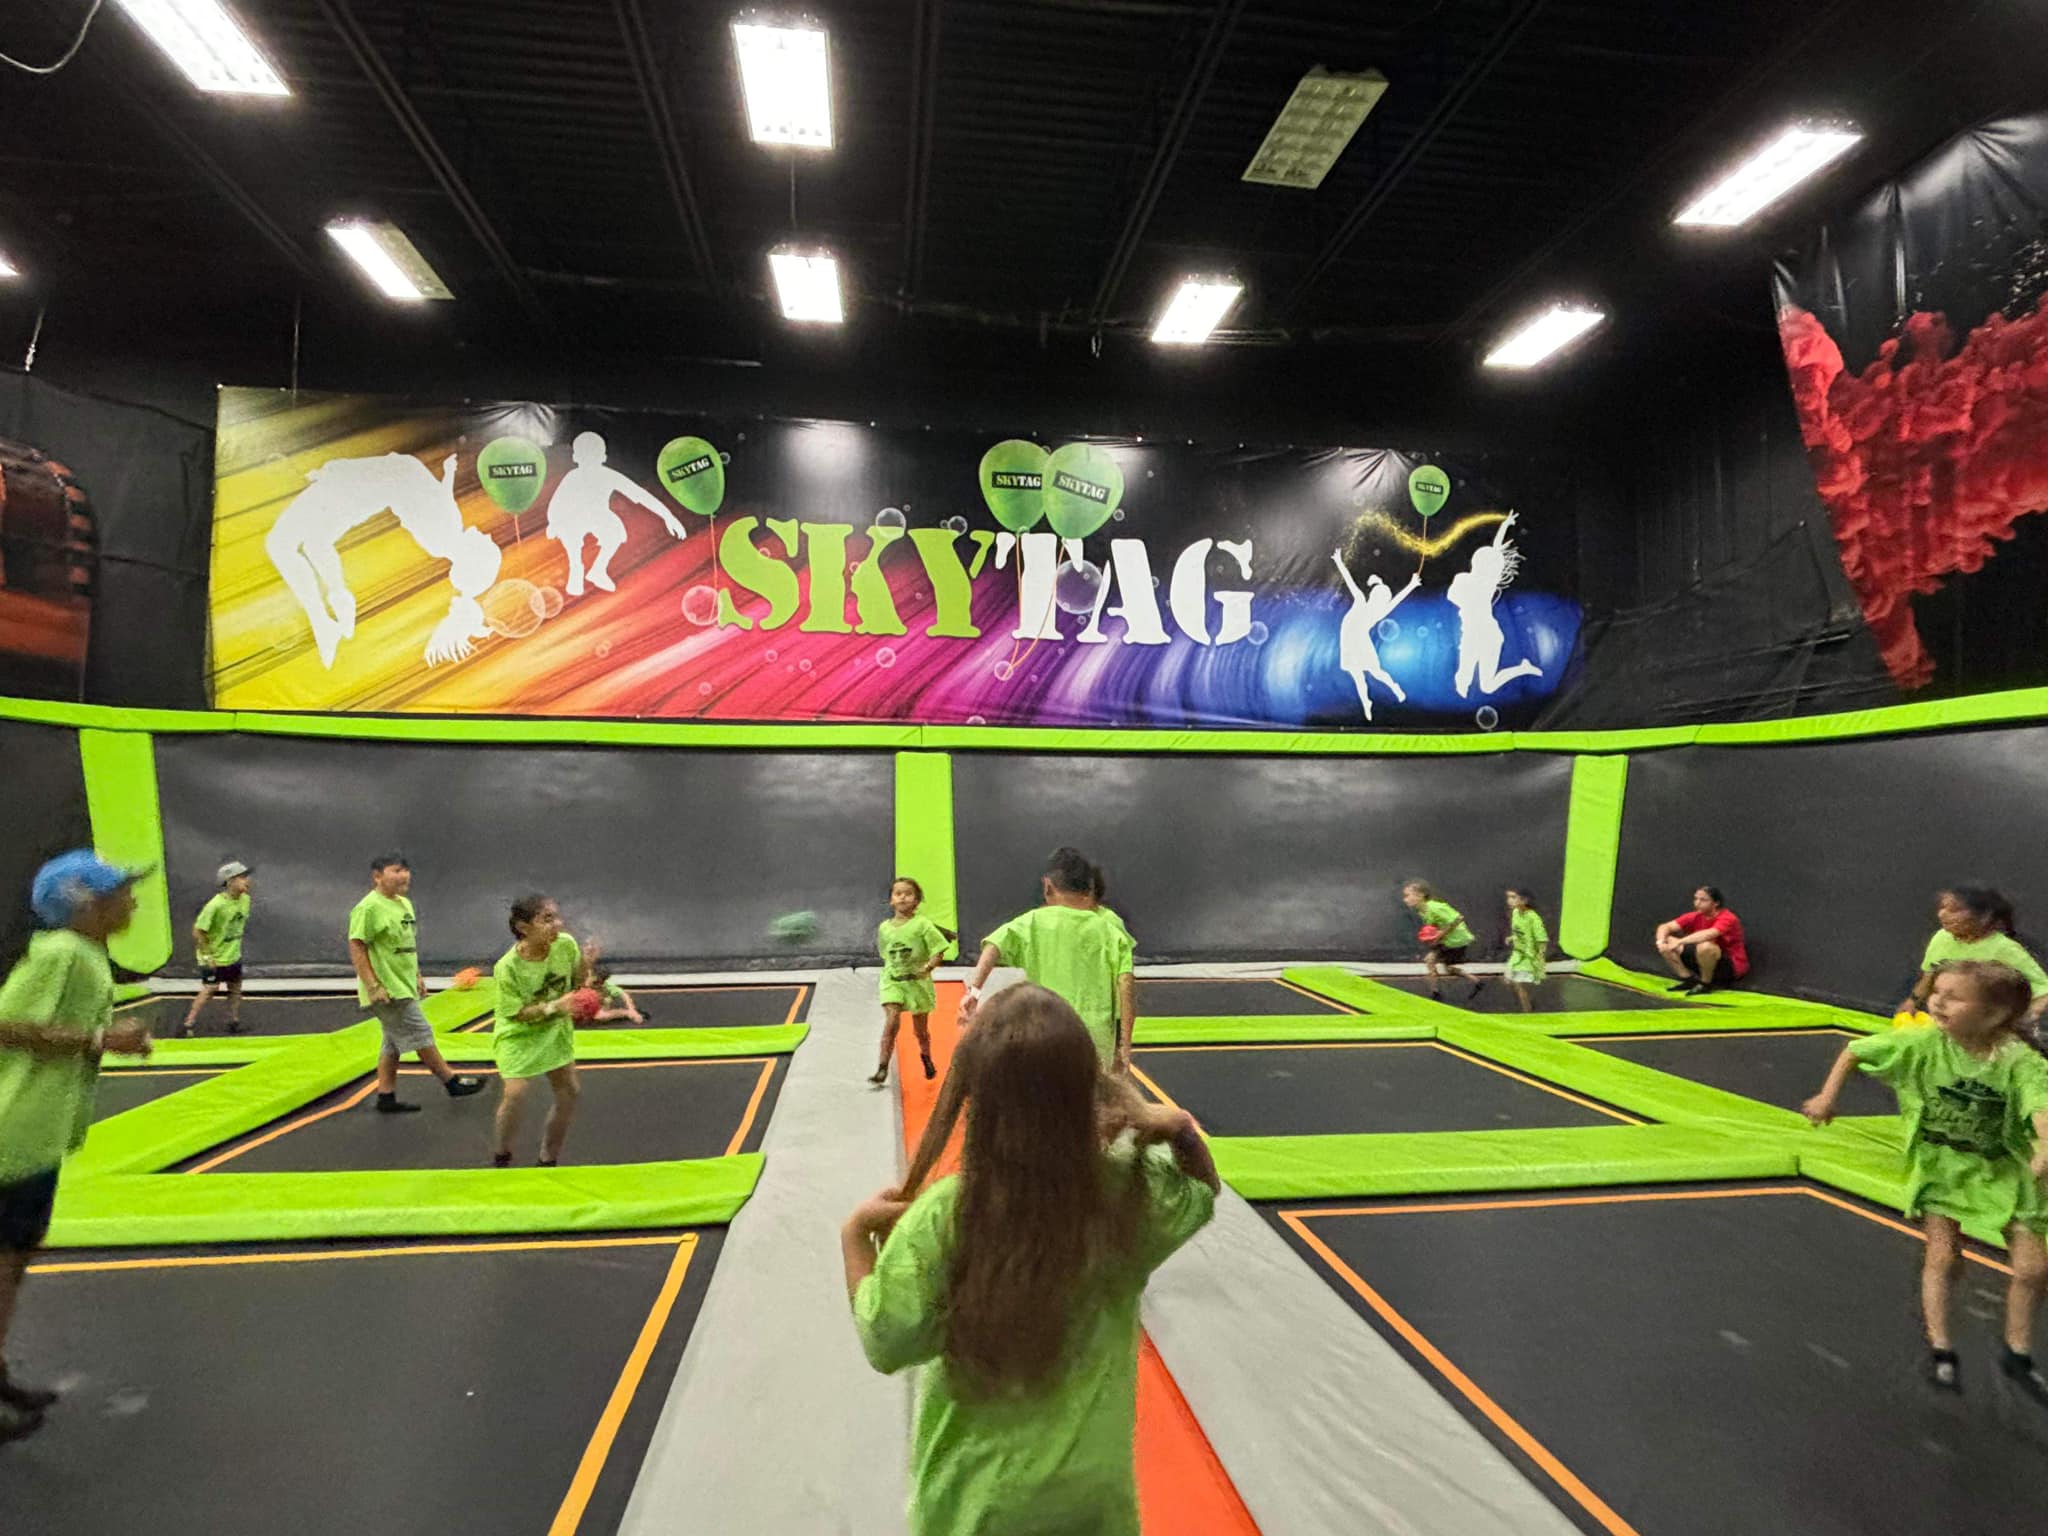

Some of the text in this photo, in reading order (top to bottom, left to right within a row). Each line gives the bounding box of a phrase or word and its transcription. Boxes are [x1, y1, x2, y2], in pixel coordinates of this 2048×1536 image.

[491, 465, 534, 477] SKYTAG
[670, 458, 710, 478] SKYTAG
[995, 475, 1041, 487] SKYTAG
[1057, 474, 1105, 500] SKYTAG
